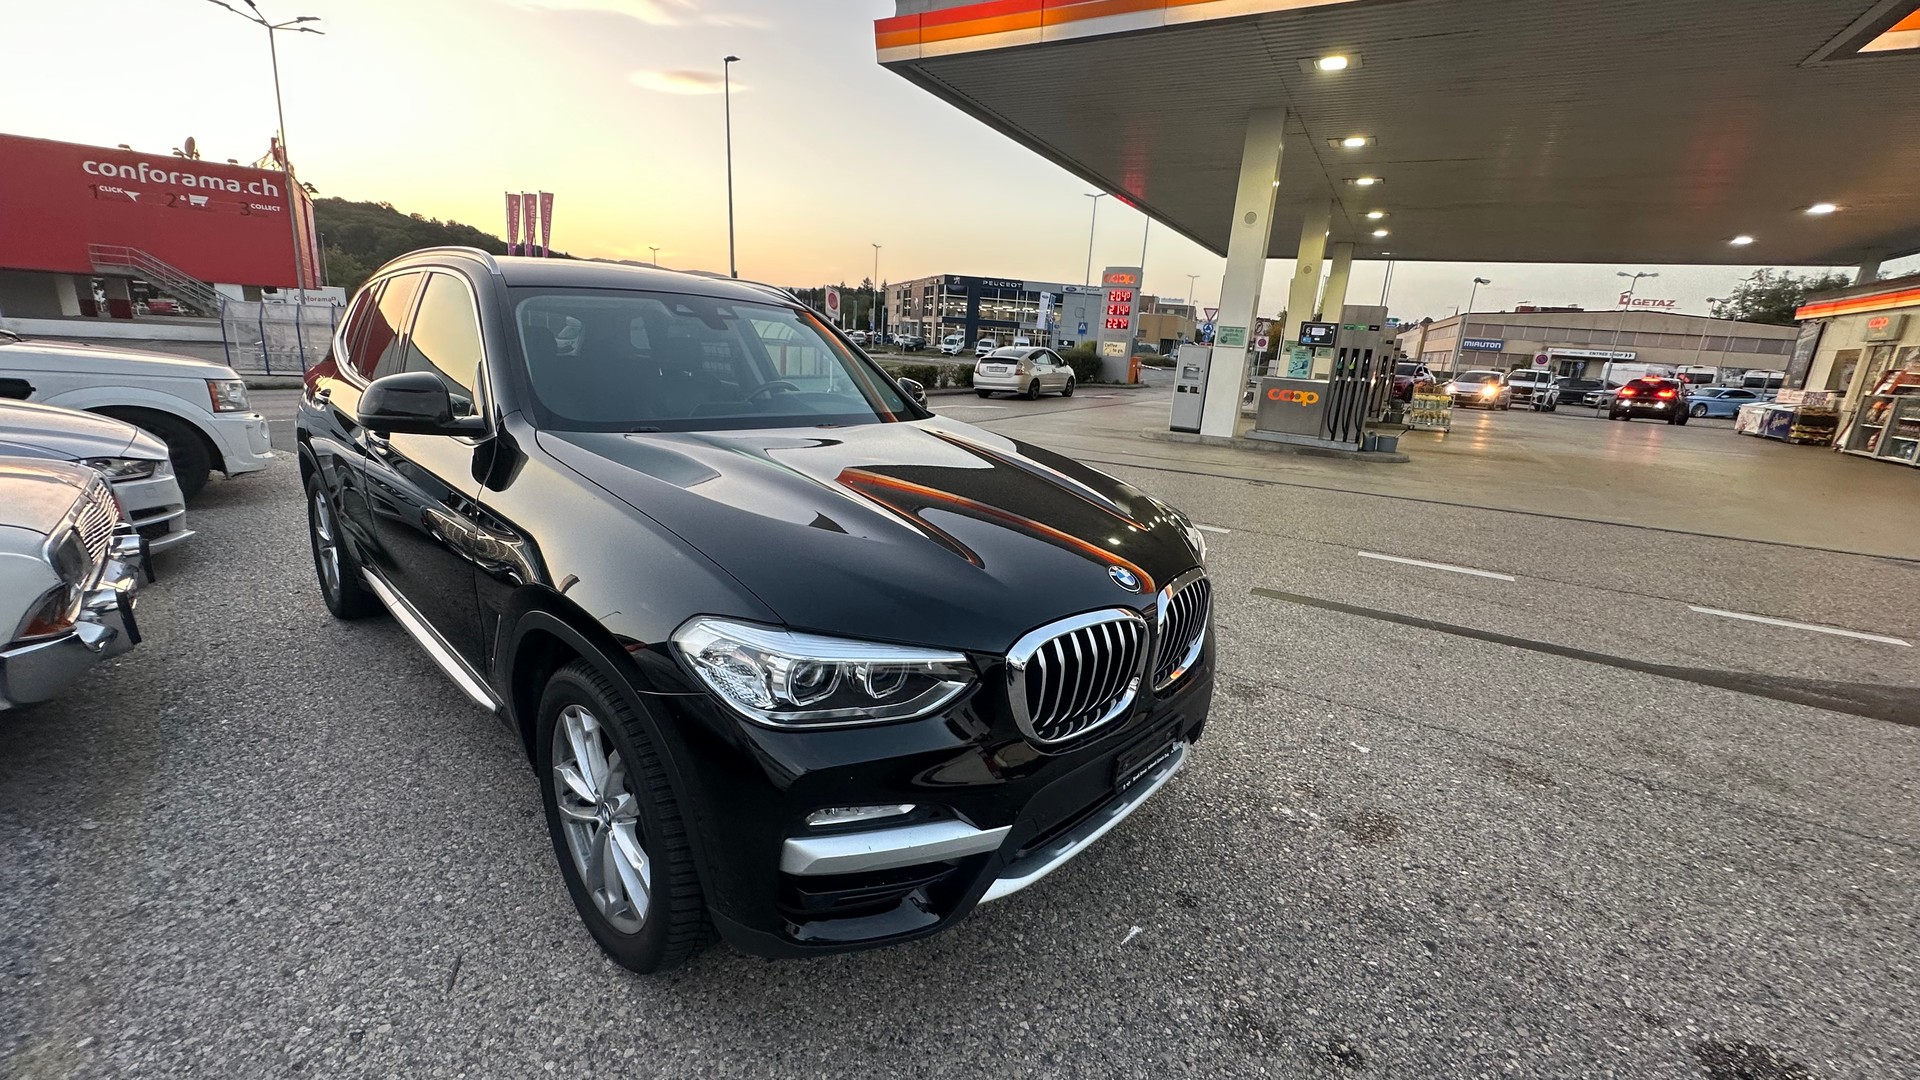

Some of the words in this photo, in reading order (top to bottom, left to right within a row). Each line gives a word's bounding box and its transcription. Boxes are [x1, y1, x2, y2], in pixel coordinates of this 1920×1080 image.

[82, 160, 279, 197] conforama.ch
[99, 185, 124, 194] CLICK
[239, 201, 251, 216] 3
[250, 203, 281, 212] COLLECT
[982, 280, 1022, 288] PEUGEOT
[1632, 298, 1676, 307] GETAZ
[1463, 340, 1502, 349] MIAUTON
[1267, 388, 1319, 406] coop
